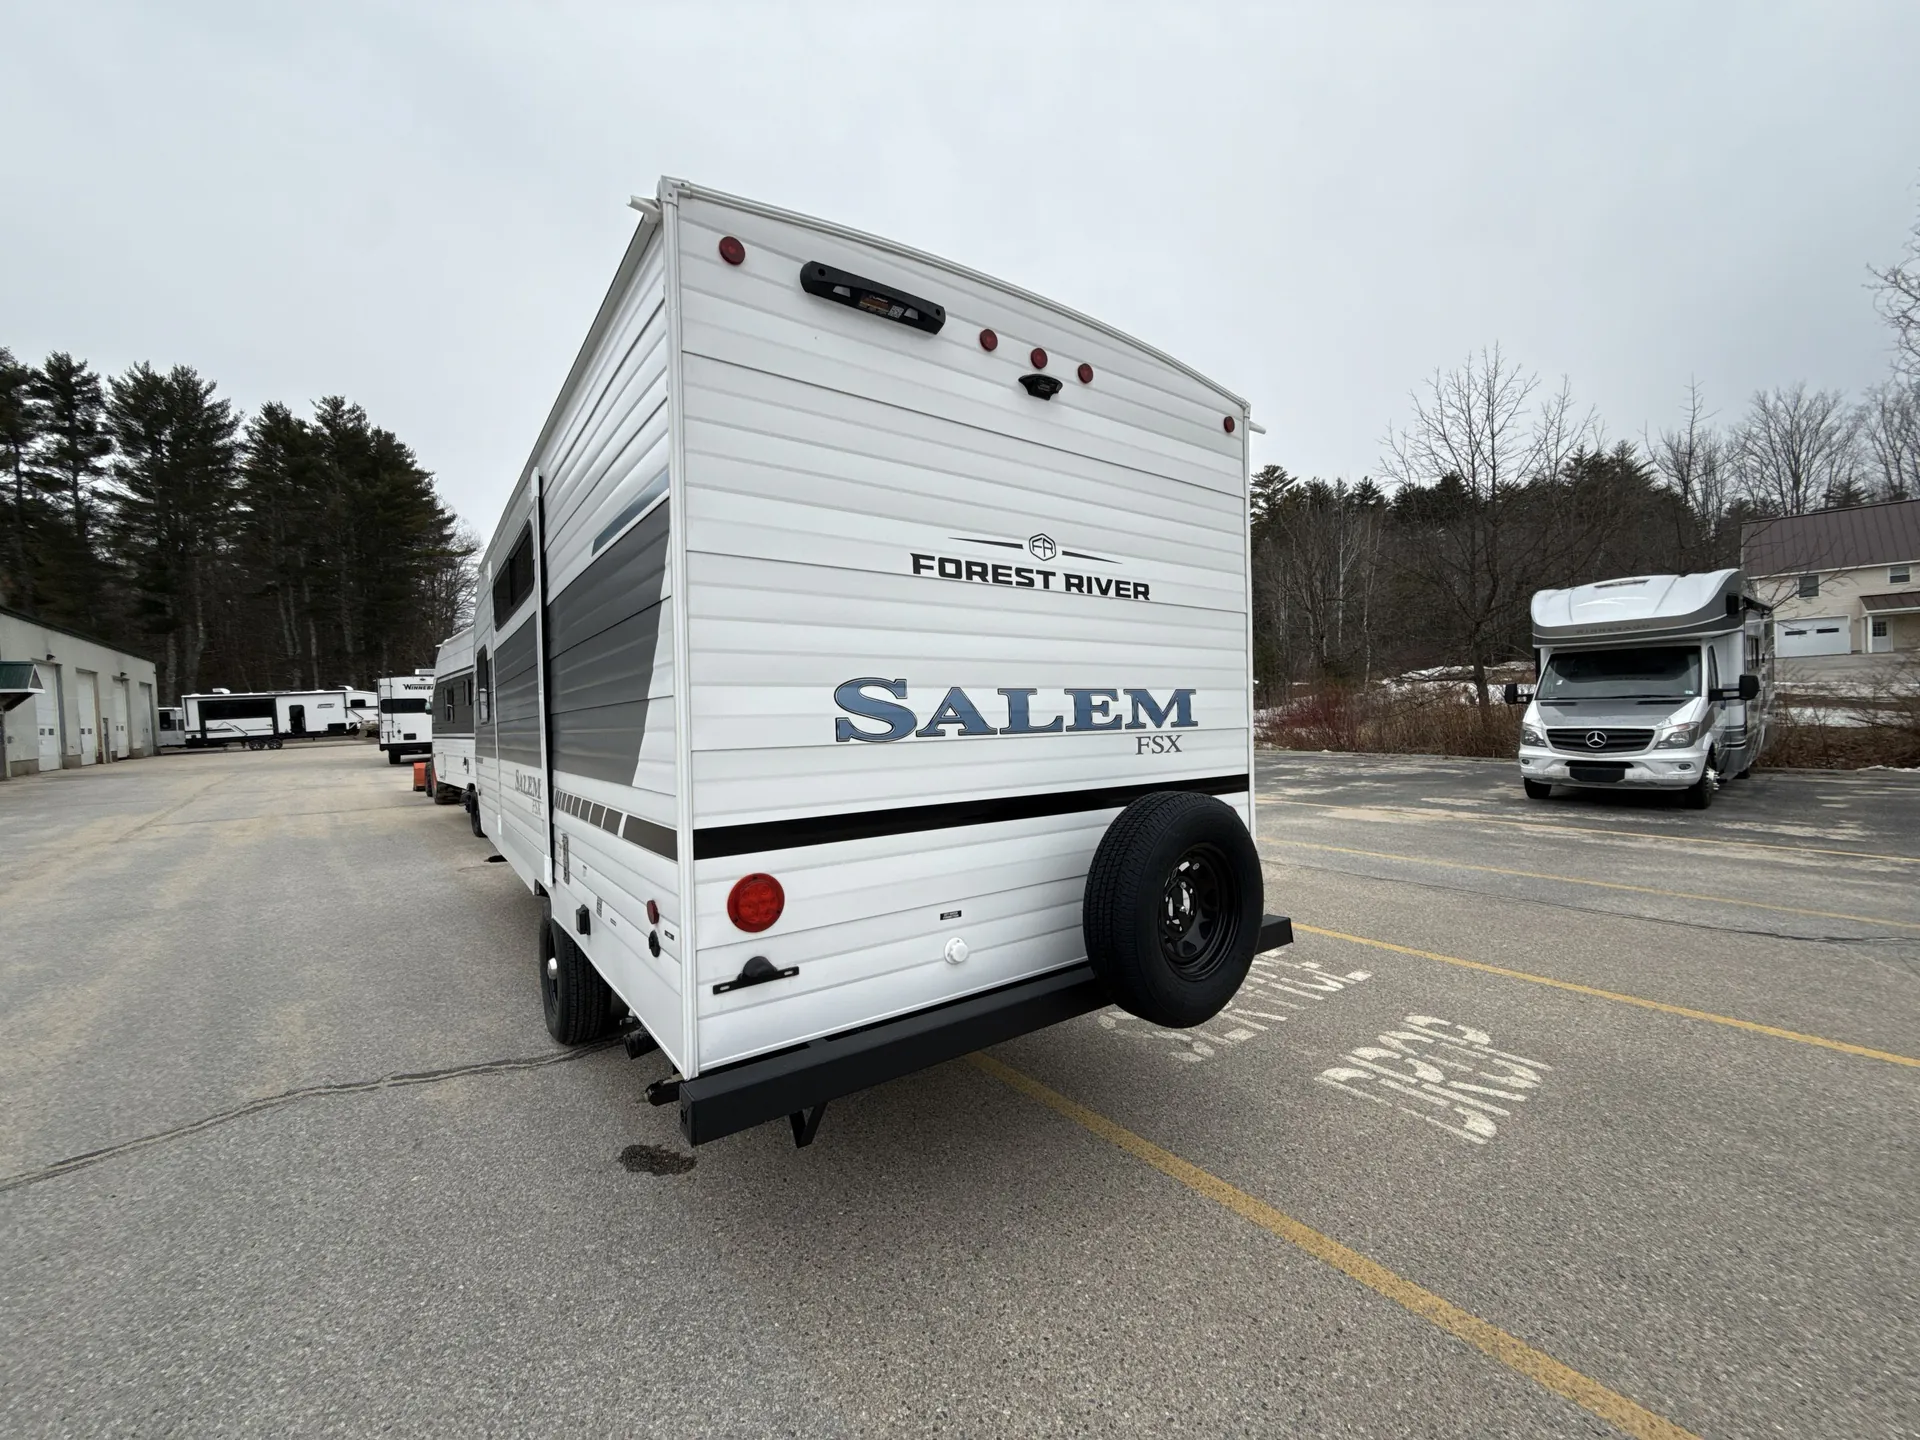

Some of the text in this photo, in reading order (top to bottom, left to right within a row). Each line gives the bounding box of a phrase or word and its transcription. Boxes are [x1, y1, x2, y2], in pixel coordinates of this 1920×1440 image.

[910, 552, 1151, 601] FOREST RIVER
[834, 677, 1199, 743] SALEM
[1135, 734, 1183, 756] FSX
[515, 769, 542, 799] SALEM
[1314, 1014, 1552, 1145] DROP
